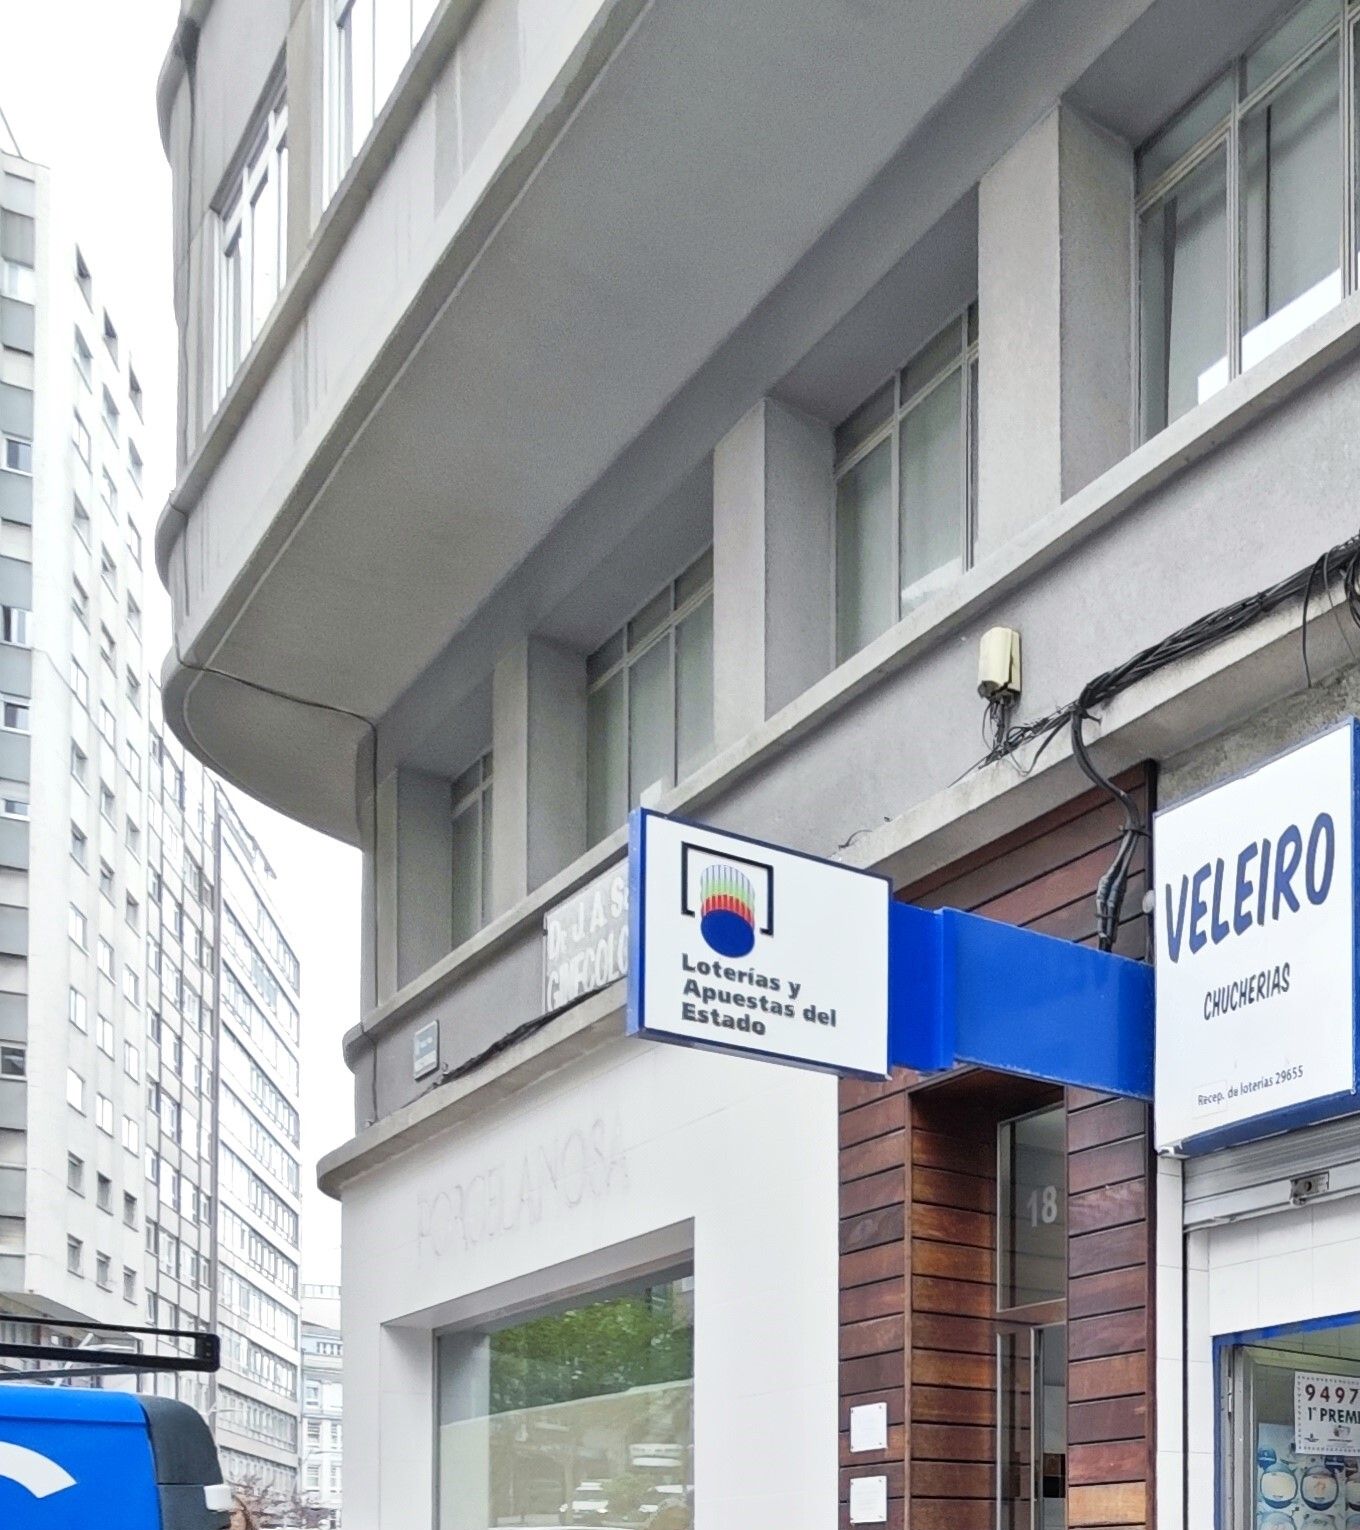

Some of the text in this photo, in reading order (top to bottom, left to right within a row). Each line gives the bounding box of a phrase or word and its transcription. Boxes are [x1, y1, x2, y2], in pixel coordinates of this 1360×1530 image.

[611, 876, 629, 918] S
[1165, 812, 1335, 964] VELEIRO
[681, 952, 801, 1000] Loterías y
[1203, 962, 1290, 1021] CHUCHERIAS
[682, 1002, 766, 1036] Estado
[683, 978, 837, 1028] Apuestas del
[1227, 1085, 1238, 1099] de
[1275, 1065, 1304, 1085] 29655
[1027, 1185, 1057, 1227] 18
